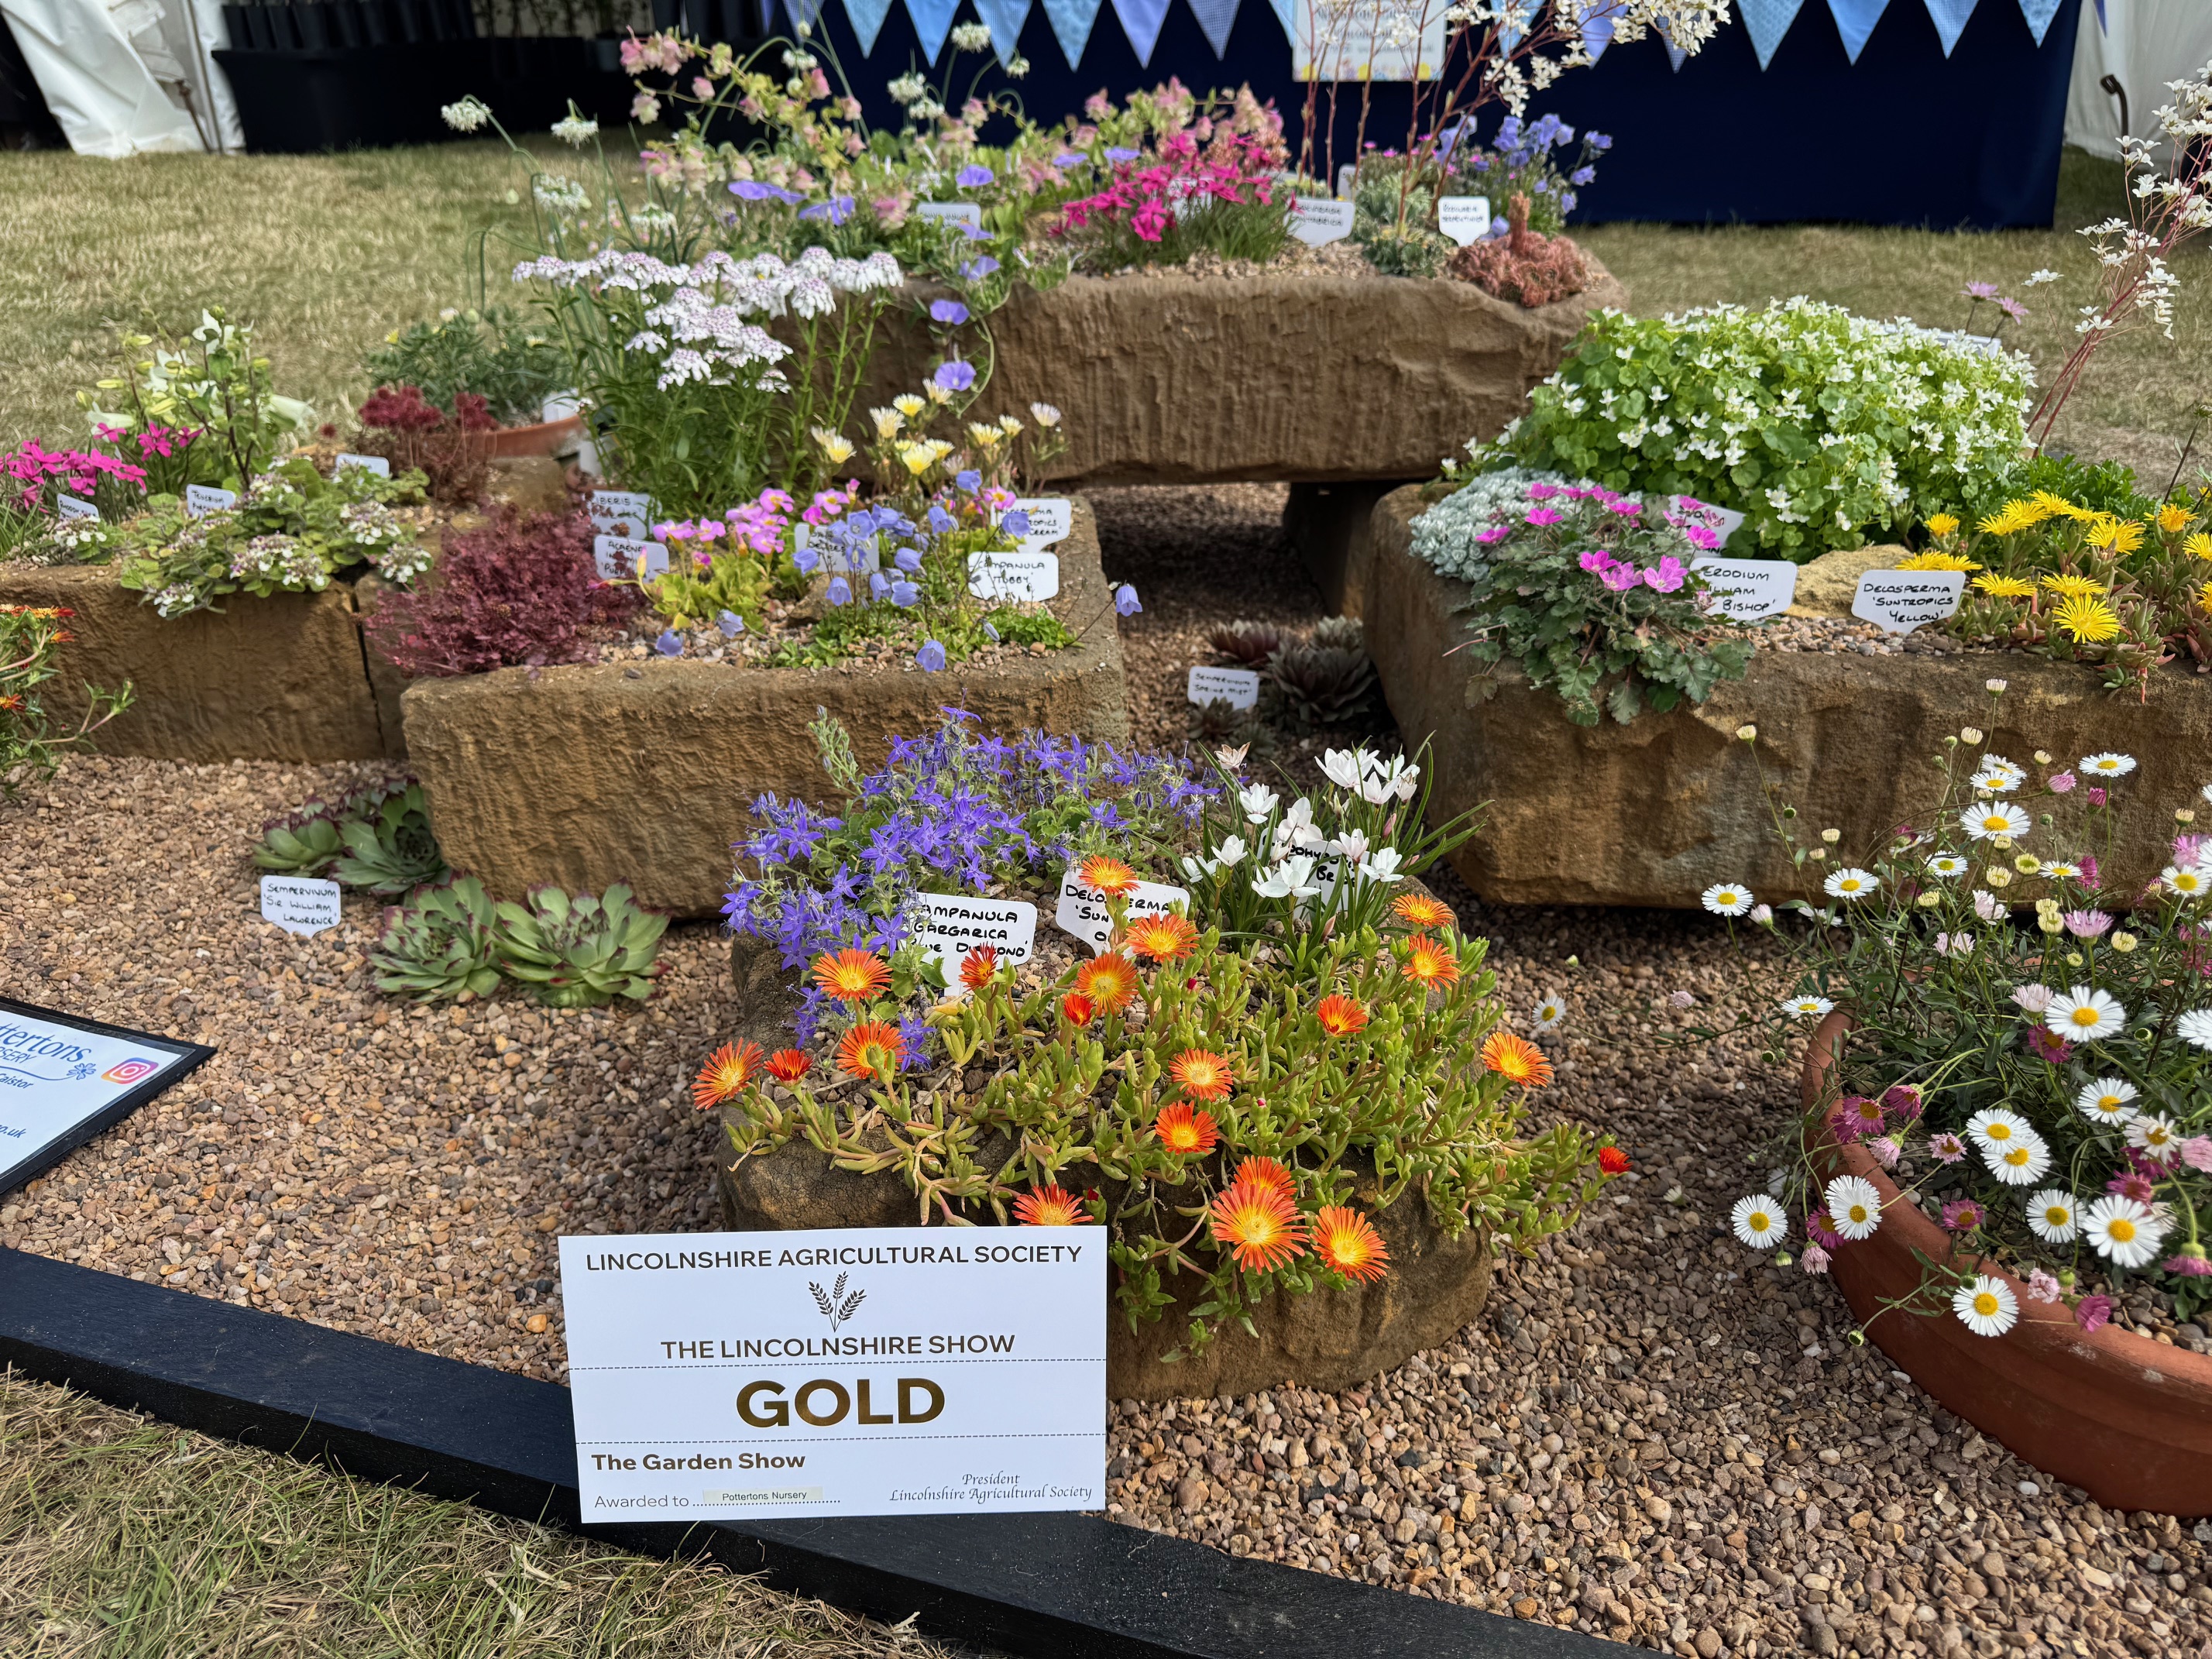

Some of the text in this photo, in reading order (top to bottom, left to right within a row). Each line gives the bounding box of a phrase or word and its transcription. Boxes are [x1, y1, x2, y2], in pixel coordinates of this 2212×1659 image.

[1703, 568, 1769, 581] ERODIUM
[1708, 585, 1755, 596] ILLIAM
[1863, 583, 1950, 593] DELOSPERMA
[1723, 599, 1775, 613] BISHOP'
[1872, 596, 1953, 606] 'SUNTROPICS
[1889, 610, 1944, 623] YELLOW'
[1065, 884, 1170, 912] DELOERMA
[290, 900, 331, 912] WILLIAM
[921, 905, 1018, 923] AMPANULA
[913, 922, 1008, 940] GARGARICA
[586, 1245, 1082, 1271] LINCOLNSHIRE AGRICULTURAL SOCIETY
[660, 1334, 1015, 1359] THE LINCOLNSHIRE SHOW
[736, 1377, 946, 1428] GOLD
[591, 1452, 805, 1471] The Garden Show
[962, 1470, 1020, 1486] President
[594, 1494, 689, 1508] Awarded to
[722, 1491, 807, 1501] Pottertons Nursery
[889, 1484, 1092, 1504] Lincolnshire Agricultural Society
